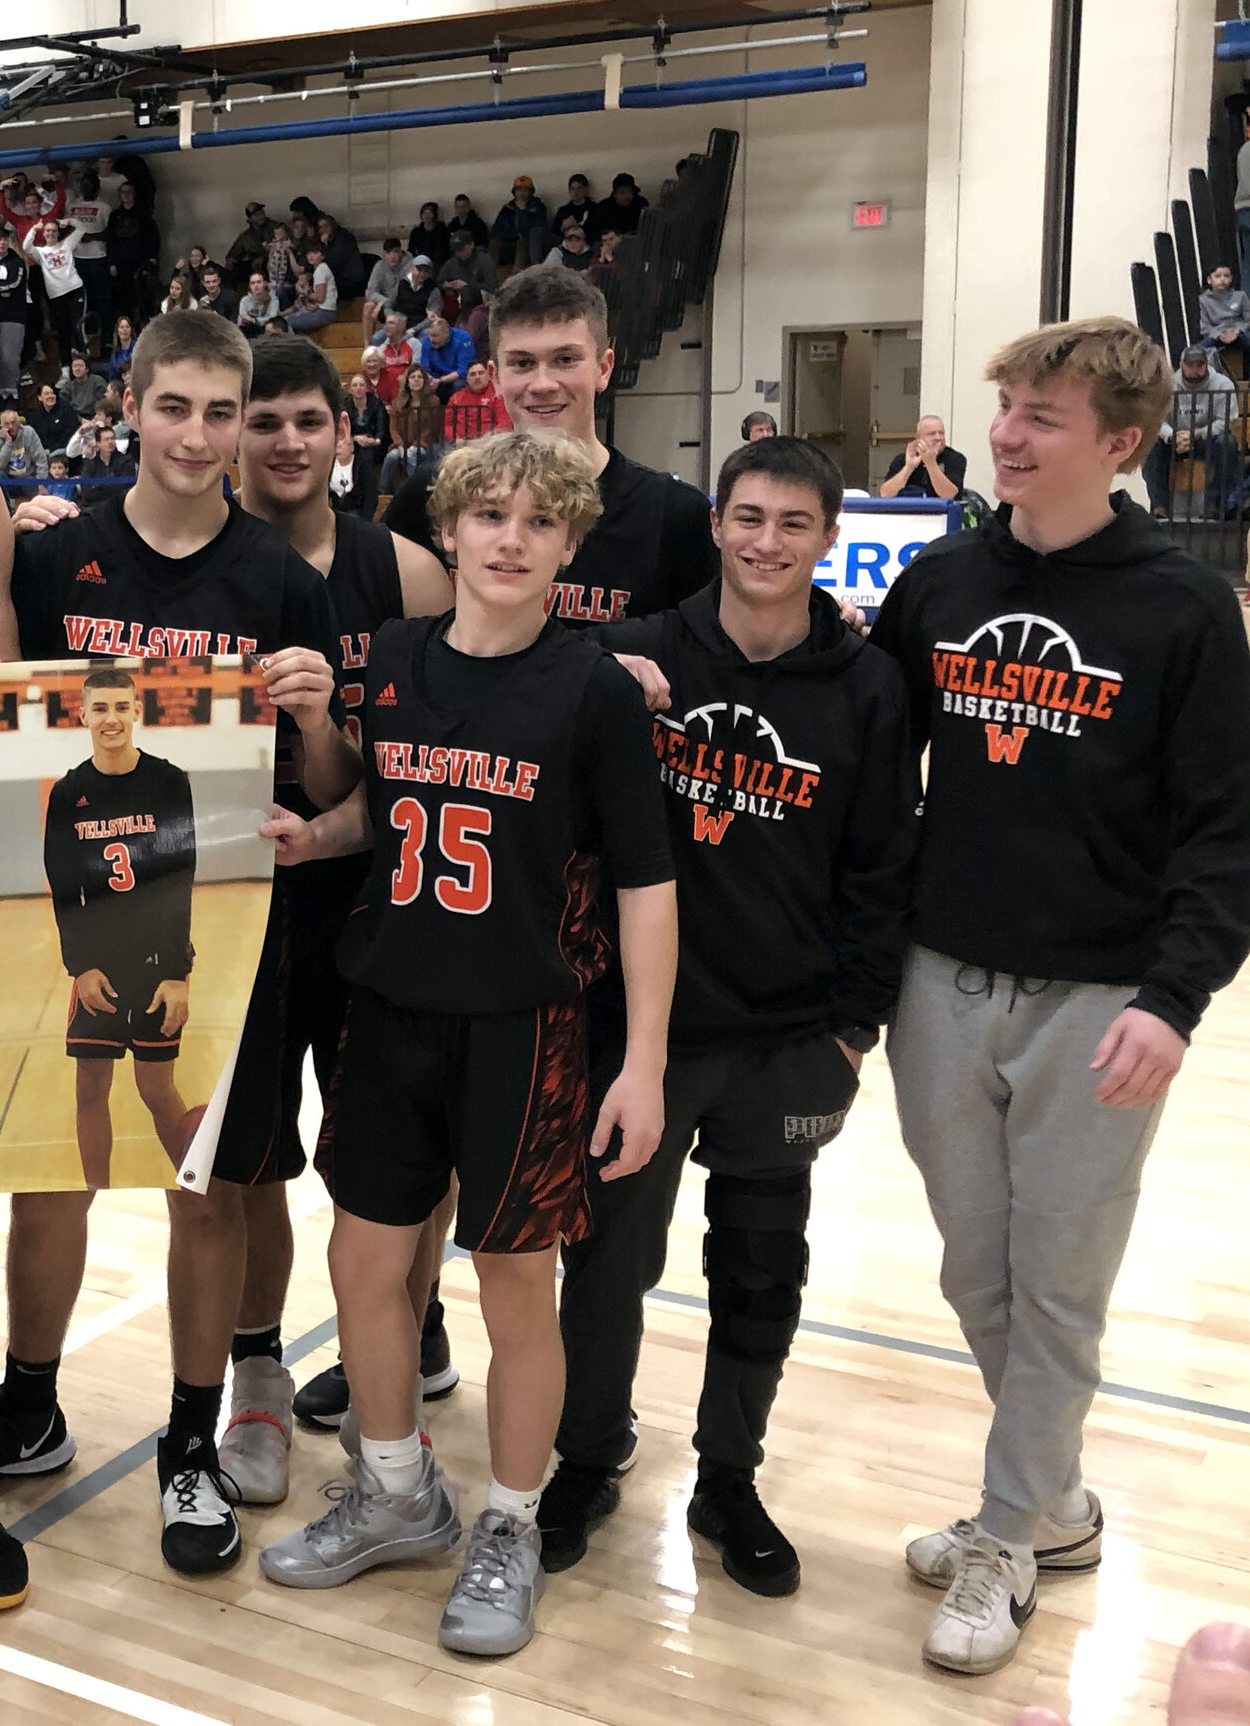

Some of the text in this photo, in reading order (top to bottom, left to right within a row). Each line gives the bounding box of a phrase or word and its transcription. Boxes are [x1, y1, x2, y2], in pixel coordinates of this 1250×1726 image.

[63, 614, 257, 659] WELLSVILLE
[932, 651, 1122, 719] WELLSVILLE
[943, 691, 1082, 737] BASKETBALL
[985, 723, 1029, 765] W
[693, 803, 734, 845] W
[103, 843, 136, 892] 3
[390, 796, 492, 915] 35
